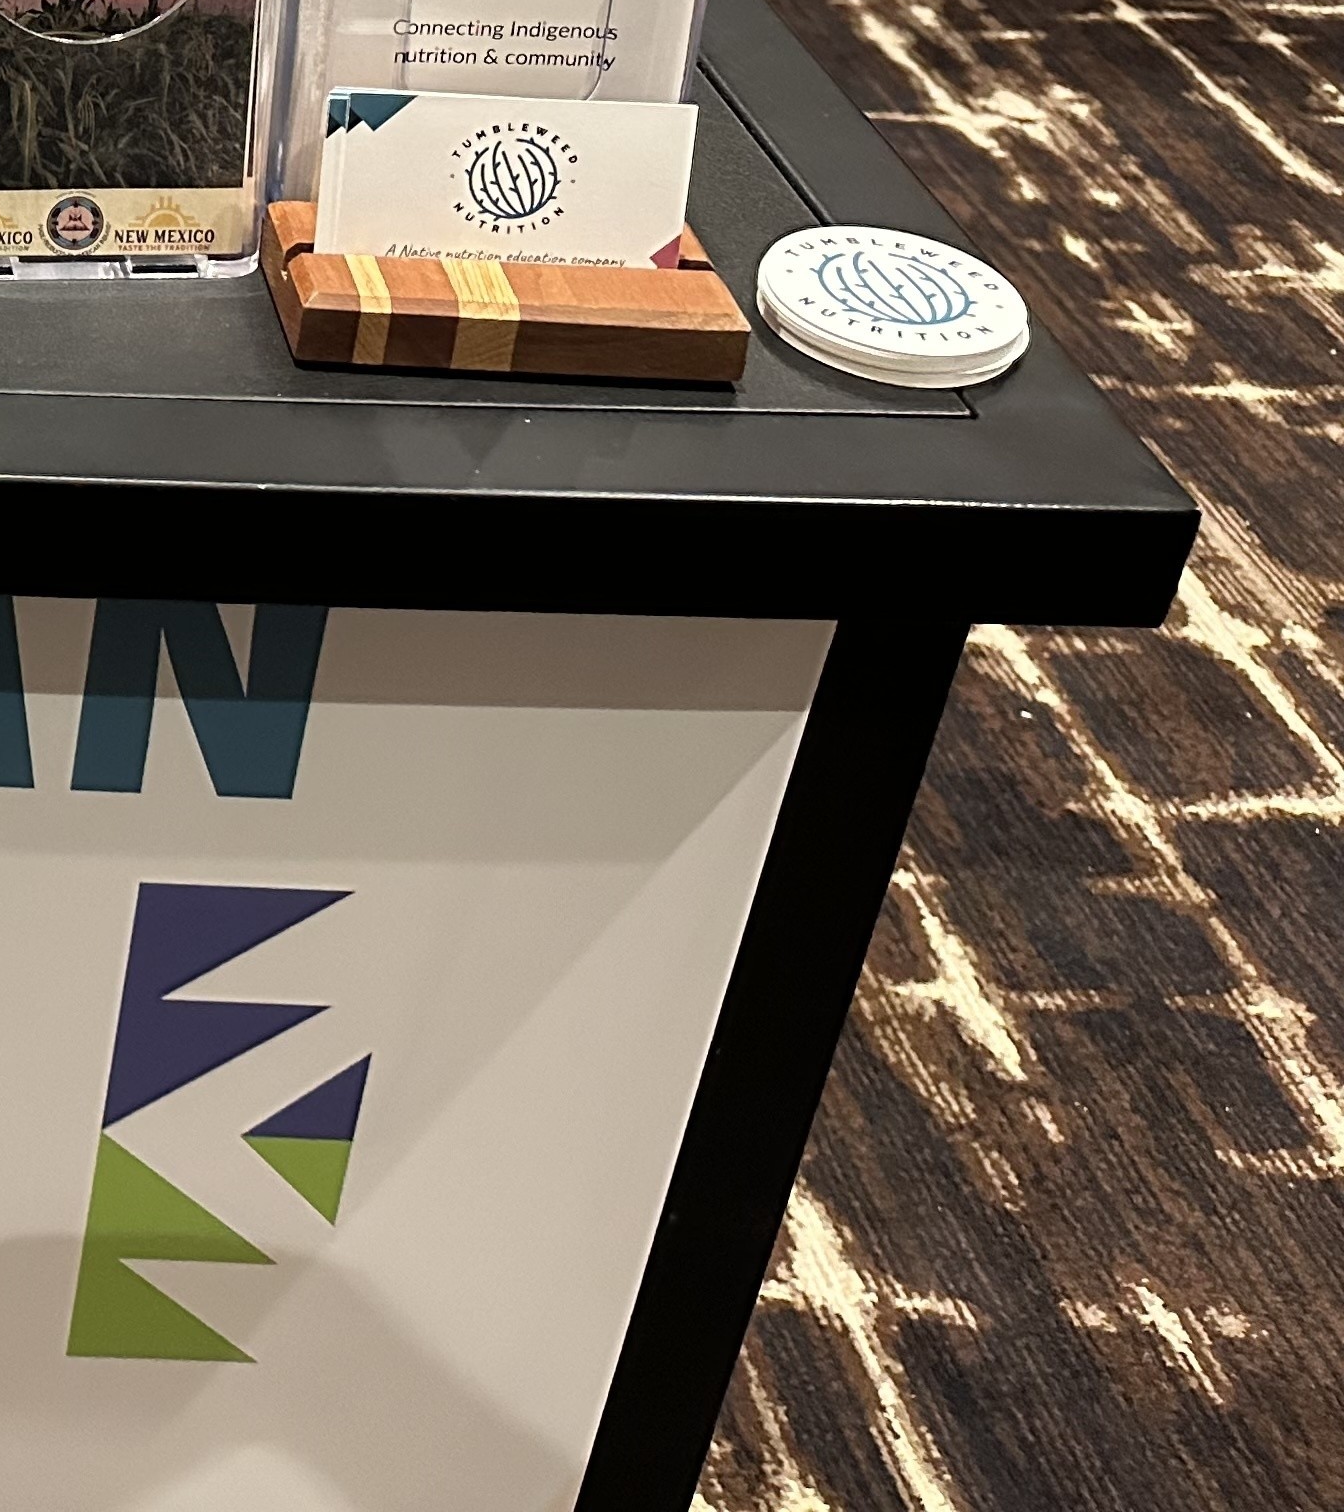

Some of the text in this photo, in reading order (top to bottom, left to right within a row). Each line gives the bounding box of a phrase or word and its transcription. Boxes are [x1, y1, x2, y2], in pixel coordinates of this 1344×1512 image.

[394, 19, 618, 42] Connecting Indigenous
[394, 47, 616, 71] nutrition & community
[452, 123, 578, 164] TUMBLEWEED
[453, 202, 564, 234] NUTRITION
[115, 230, 148, 243] NEW
[155, 230, 215, 243] MEXICO
[385, 244, 396, 257] A
[399, 244, 441, 258] Native
[446, 250, 501, 260] nutrition
[507, 252, 566, 263] education
[785, 238, 999, 291] TUMBLEWEED
[799, 297, 993, 341] NUTRITION
